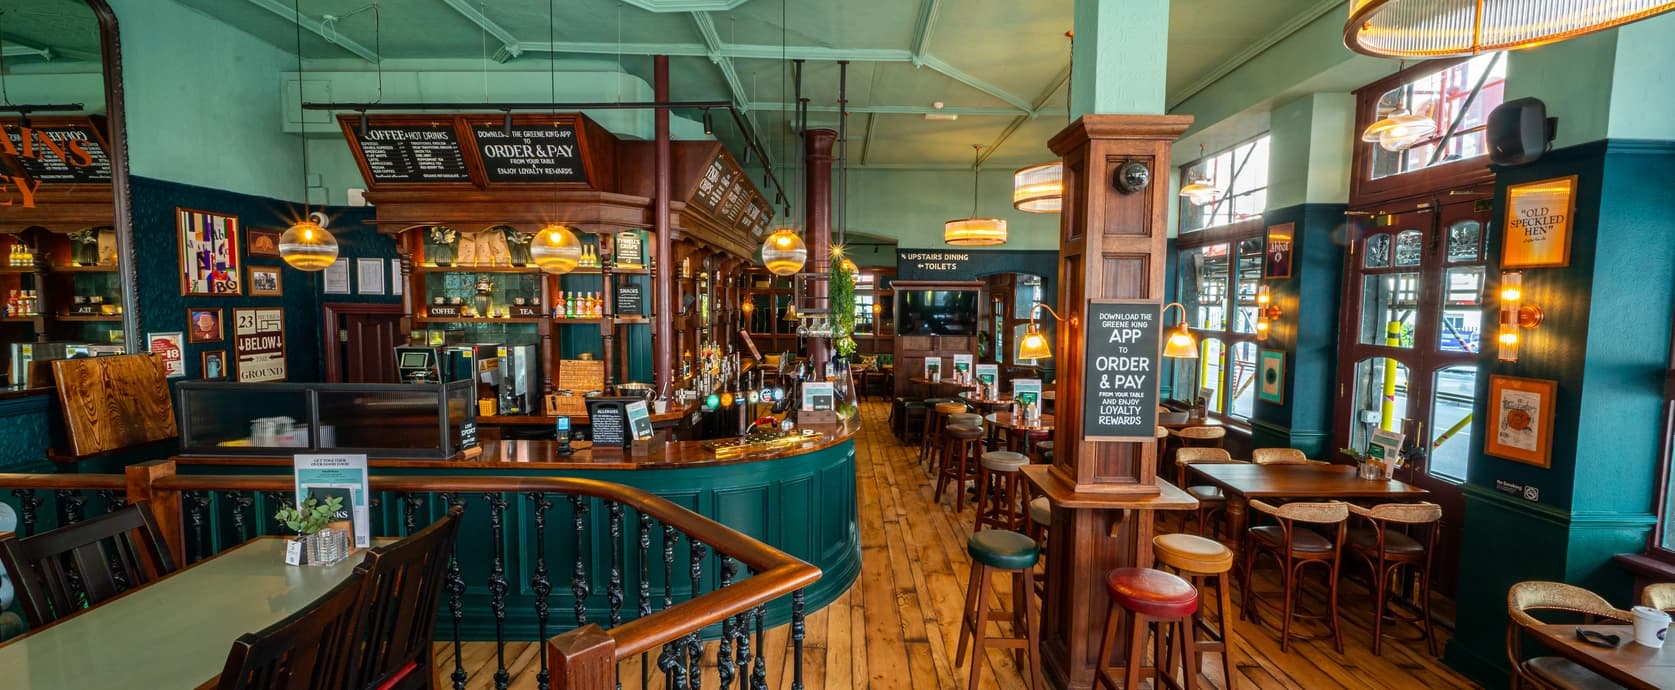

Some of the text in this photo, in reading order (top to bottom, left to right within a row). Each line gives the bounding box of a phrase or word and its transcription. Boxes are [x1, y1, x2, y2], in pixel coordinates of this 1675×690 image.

[484, 145, 574, 158] ORDER & PAY
[1511, 214, 1565, 228] SPECKLED
[238, 316, 253, 329] 23
[1099, 313, 1153, 321] DOWNLOAD THE
[246, 335, 275, 351] BELOW
[1109, 329, 1142, 343] APP
[1095, 356, 1150, 371] ORDER
[241, 367, 284, 381] GROUND
[1099, 374, 1146, 389] & PAY
[1100, 406, 1142, 415] LOYALTY
[1098, 416, 1142, 425] REWARDS
